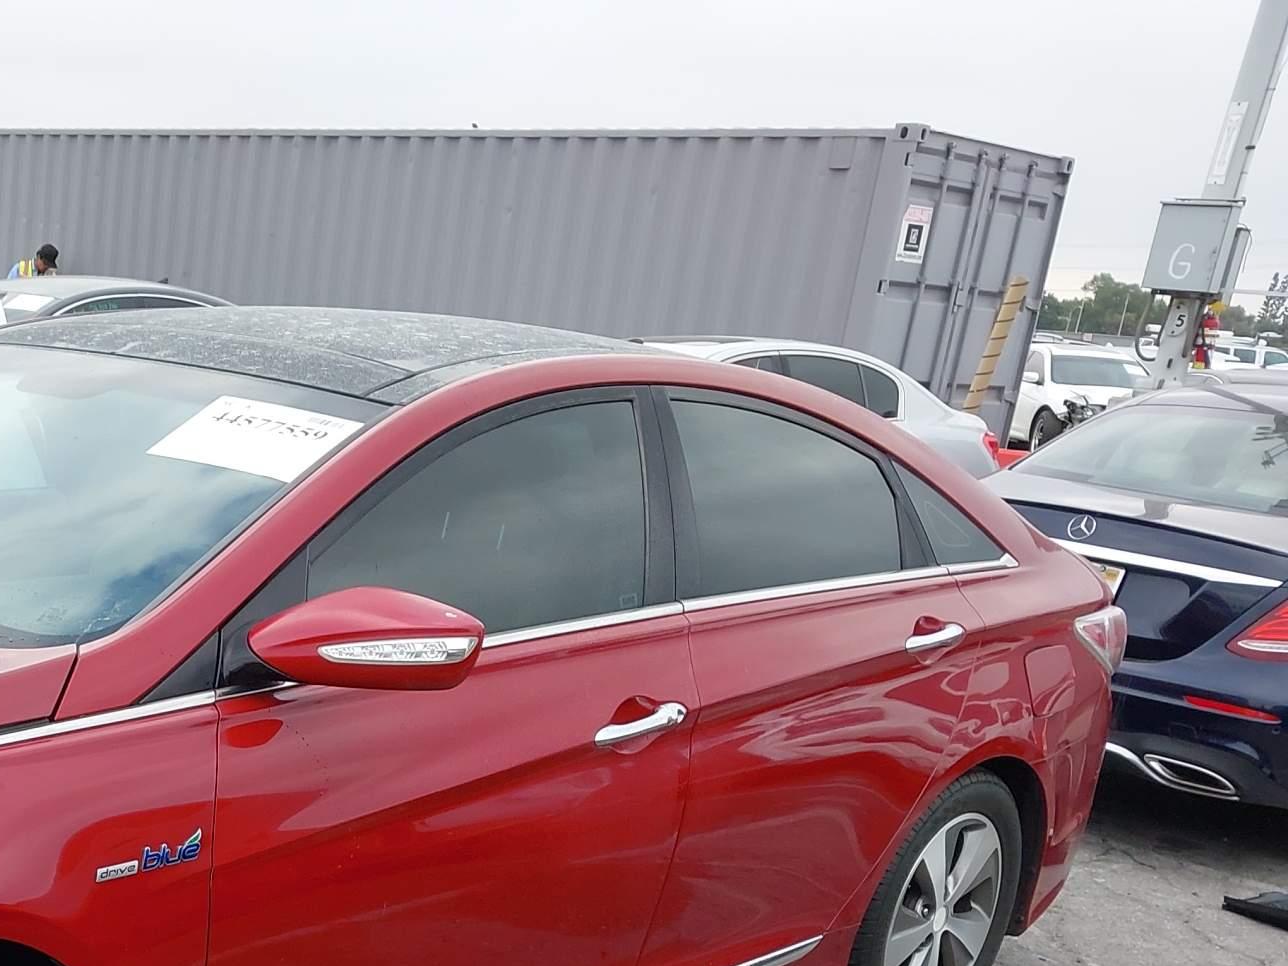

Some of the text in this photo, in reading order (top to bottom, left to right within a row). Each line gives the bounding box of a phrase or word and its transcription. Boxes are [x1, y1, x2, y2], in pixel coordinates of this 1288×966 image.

[1168, 243, 1195, 280] G
[1175, 314, 1186, 327] 5
[212, 411, 329, 441] 44577559
[99, 842, 202, 879] drive blue
